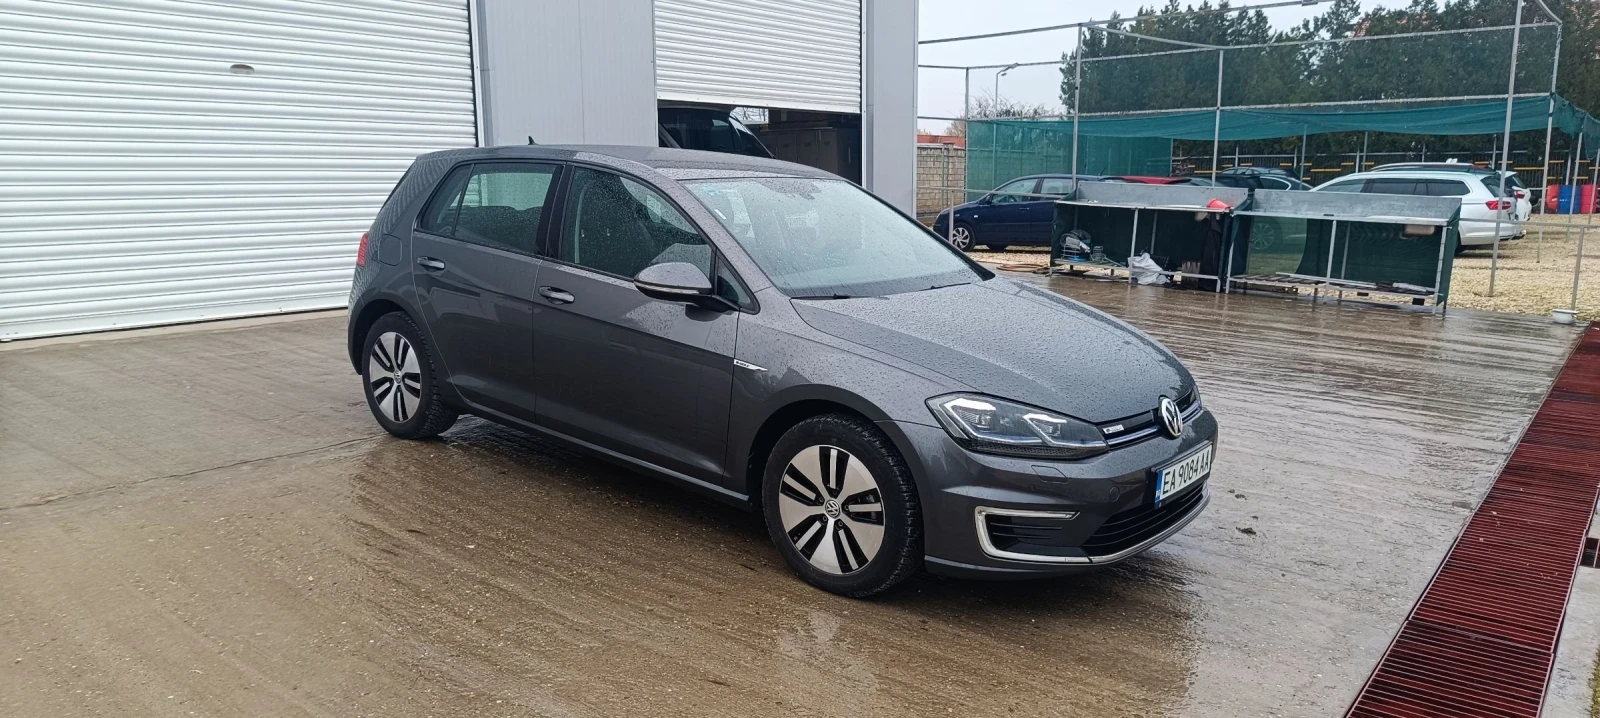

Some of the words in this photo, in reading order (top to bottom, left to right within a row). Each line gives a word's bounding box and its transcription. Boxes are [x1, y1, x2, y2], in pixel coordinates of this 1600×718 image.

[1163, 468, 1176, 495] EA
[1179, 455, 1200, 486] 9084
[1199, 449, 1210, 475] AA
